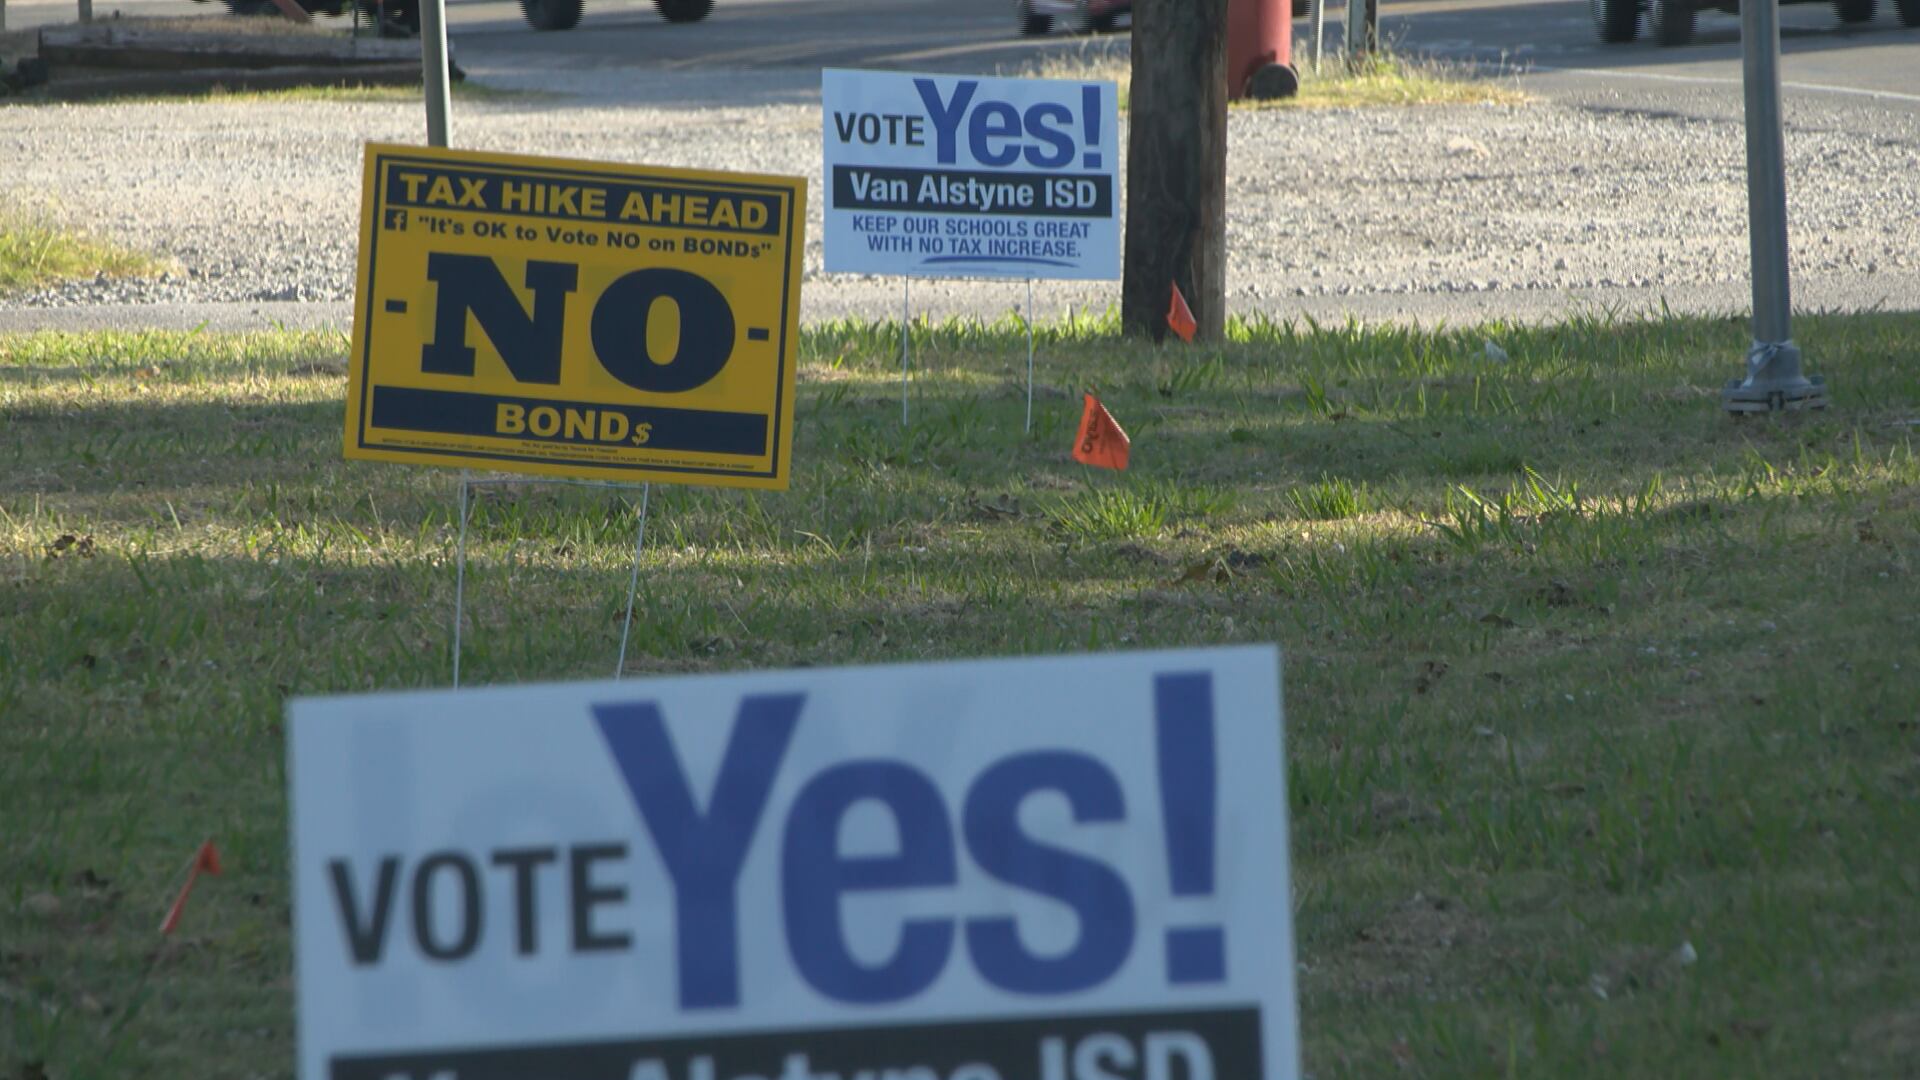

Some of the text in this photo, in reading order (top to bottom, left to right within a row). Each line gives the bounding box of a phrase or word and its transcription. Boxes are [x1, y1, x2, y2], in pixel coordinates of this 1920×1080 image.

[833, 78, 1103, 170] VOTE Yes!
[400, 173, 769, 231] TAX HIKE AHEAD
[850, 171, 1098, 212] Van Alstyne ISD
[472, 219, 507, 238] OK
[515, 225, 538, 242] to
[546, 226, 599, 247] Vote
[606, 231, 641, 250] NO
[648, 237, 675, 252] on
[852, 215, 1091, 239] KEEP OUR SCHOOLS GREAT
[867, 235, 1081, 258] WITH NO TAX INCREASE.
[495, 403, 653, 446] BOND$
[327, 670, 1228, 1013] VOTE Yes!
